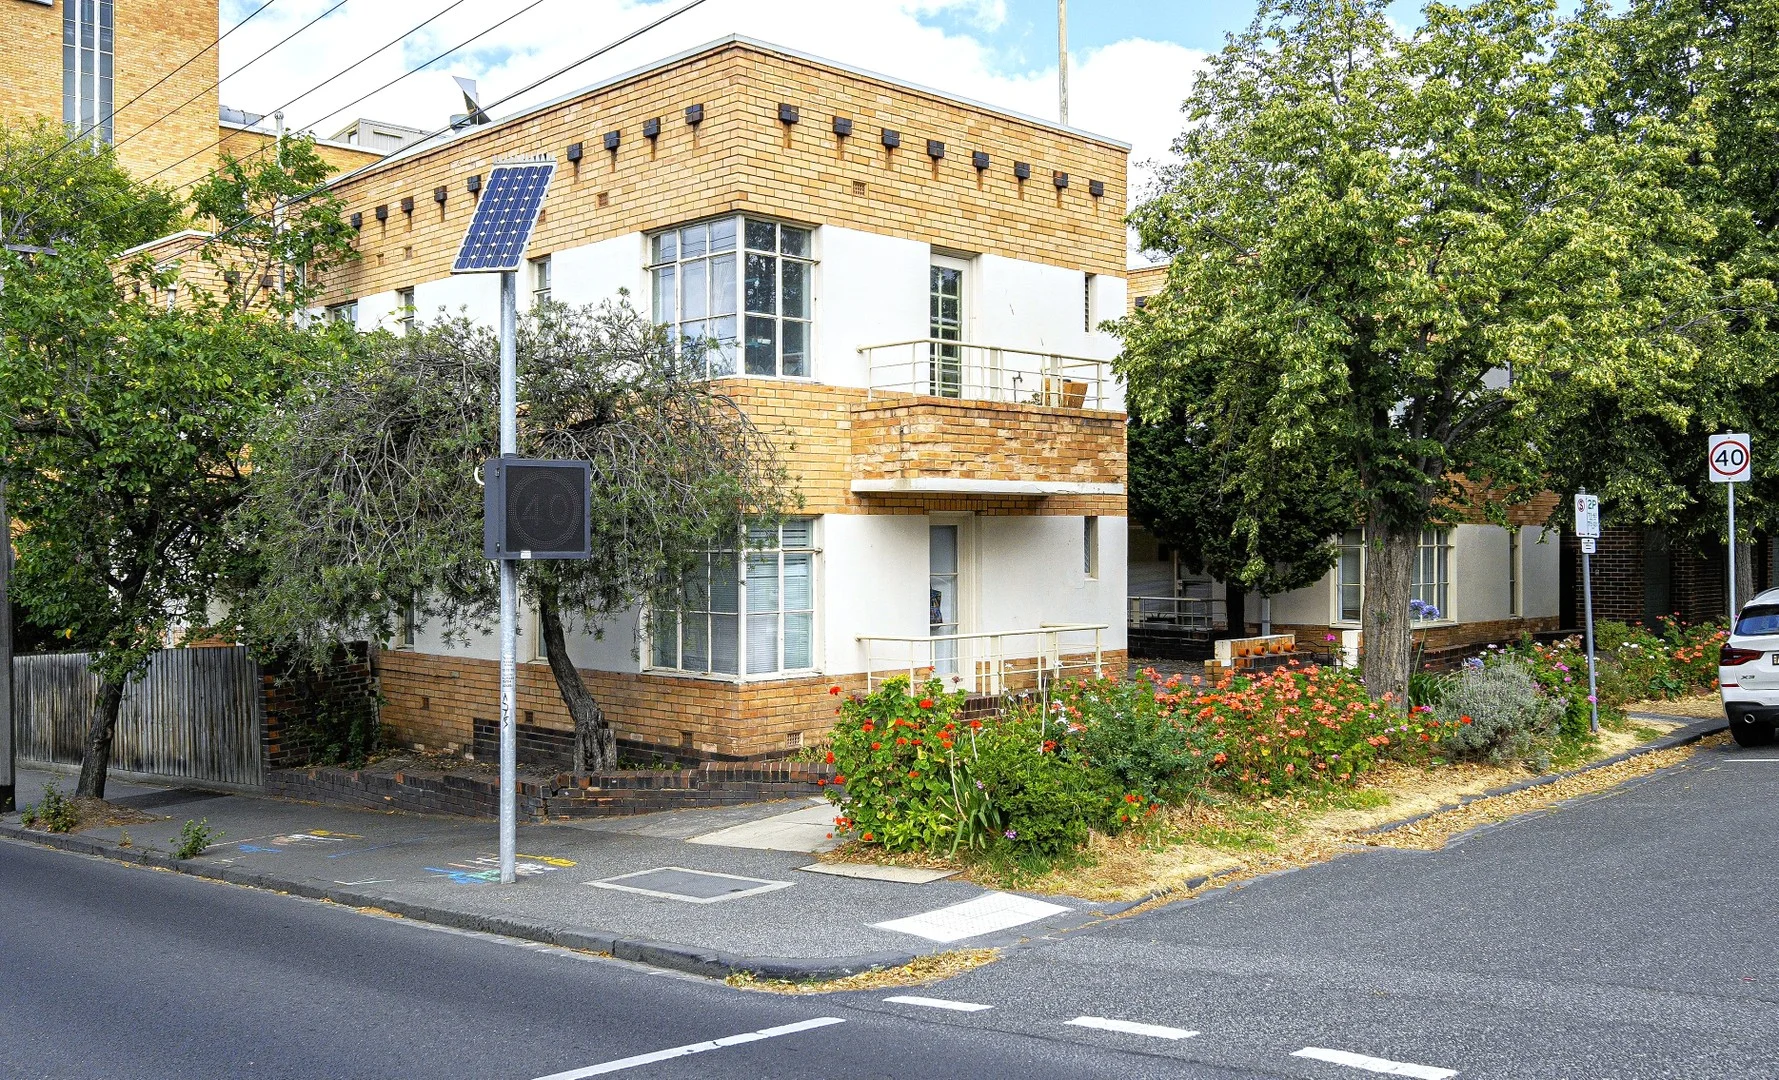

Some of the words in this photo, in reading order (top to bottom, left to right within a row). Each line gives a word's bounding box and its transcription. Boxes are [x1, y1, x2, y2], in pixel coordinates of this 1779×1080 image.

[1714, 449, 1744, 467] 40
[521, 492, 570, 525] 40
[1587, 499, 1597, 510] 2P
